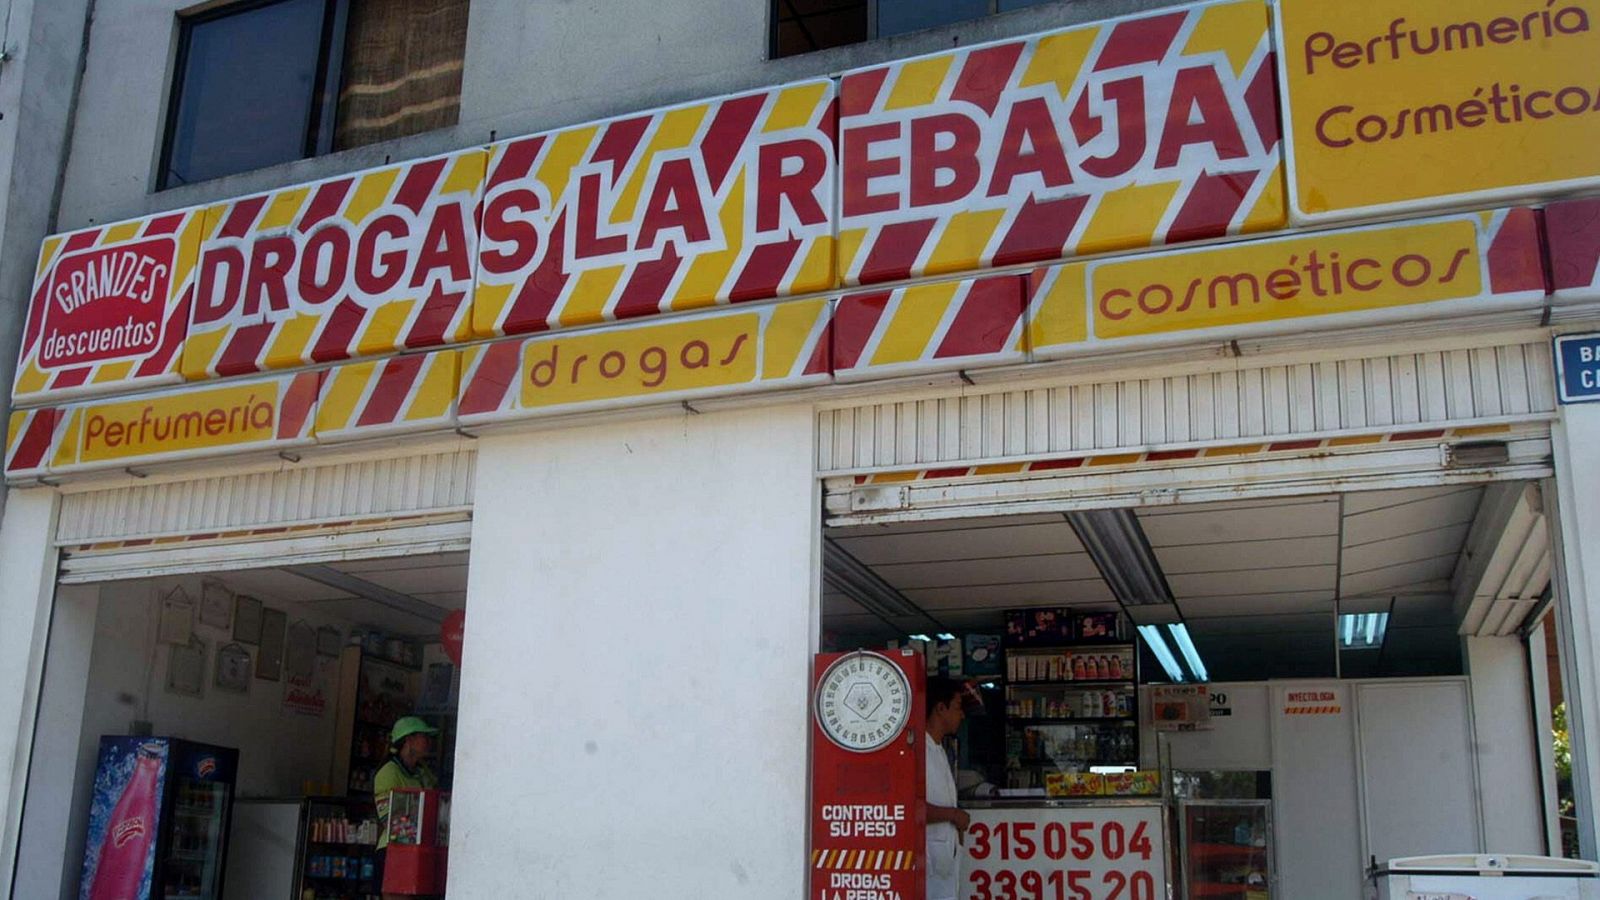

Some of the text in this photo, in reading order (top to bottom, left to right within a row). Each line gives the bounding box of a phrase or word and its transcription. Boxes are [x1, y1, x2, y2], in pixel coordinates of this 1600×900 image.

[1304, 0, 1590, 75] Perfumería
[193, 64, 1249, 325] DROGAS LA REBAJA
[55, 250, 167, 316] GRANDES
[1099, 248, 1470, 321] cosméticos
[44, 320, 156, 361] descuentos
[530, 333, 749, 388] drogas
[85, 395, 274, 451] Perfumería
[822, 805, 905, 821] CONTROLE
[830, 821, 896, 837] SU PESO
[831, 873, 891, 889] DROGAS
